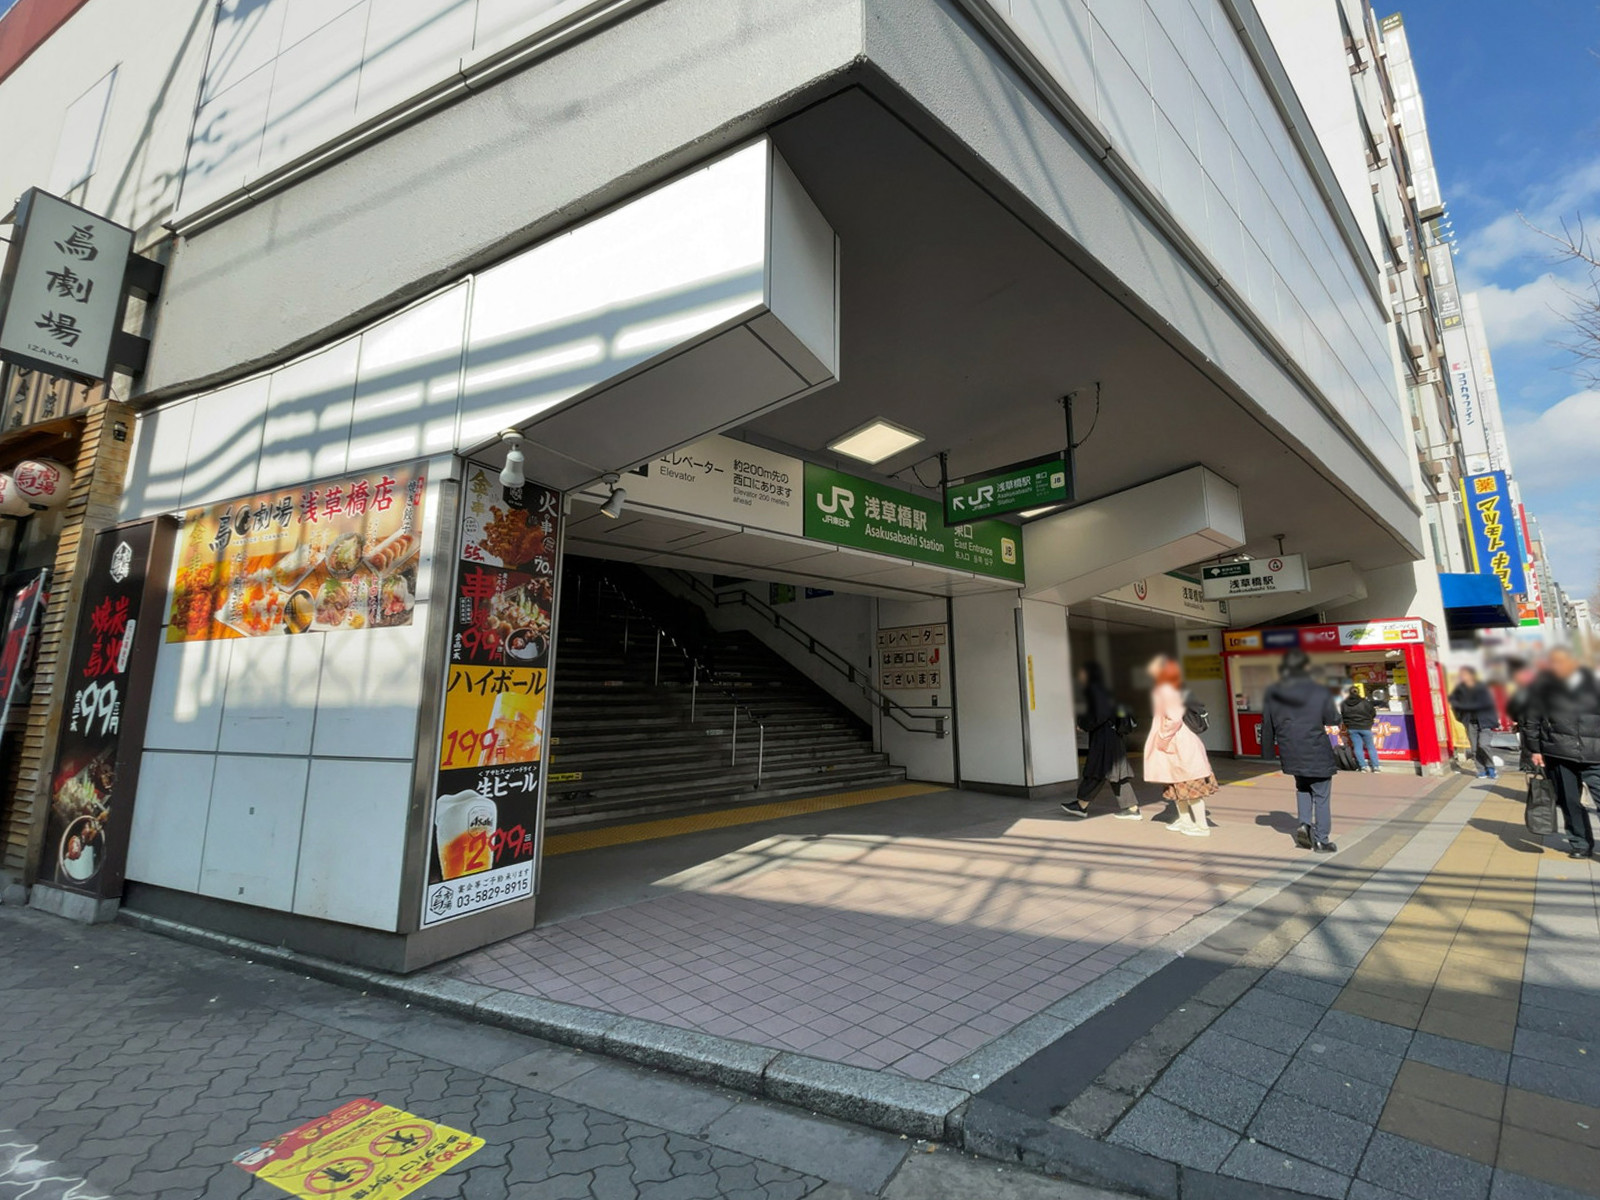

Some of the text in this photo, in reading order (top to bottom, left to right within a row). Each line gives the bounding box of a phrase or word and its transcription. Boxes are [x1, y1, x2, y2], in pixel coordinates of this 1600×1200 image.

[34, 225, 99, 347] 鳥劇場
[27, 344, 80, 365] IZAKAYA
[659, 465, 696, 483] Elevator
[733, 459, 789, 484] 約200m先の
[733, 473, 792, 498] 西口にあります
[996, 476, 1031, 493] 浅草橋駅
[297, 475, 397, 524] 浅草橋店
[733, 487, 758, 499] Elevator
[770, 495, 790, 507] meters
[816, 485, 855, 519] JR
[968, 485, 994, 506] JR
[822, 516, 851, 528] JR東日本
[864, 495, 928, 532] 浅草橋駅
[865, 523, 945, 553] Asakusabashi Station
[954, 524, 973, 539] 東口
[954, 539, 993, 556] East Entrance
[1230, 575, 1274, 589] 浅草橋駅
[883, 652, 926, 665] は西口に
[447, 668, 547, 696] ハイボール
[476, 772, 538, 798] 生ビール
[470, 816, 494, 828] Asahi
[457, 878, 529, 908] 03-5829-8915
